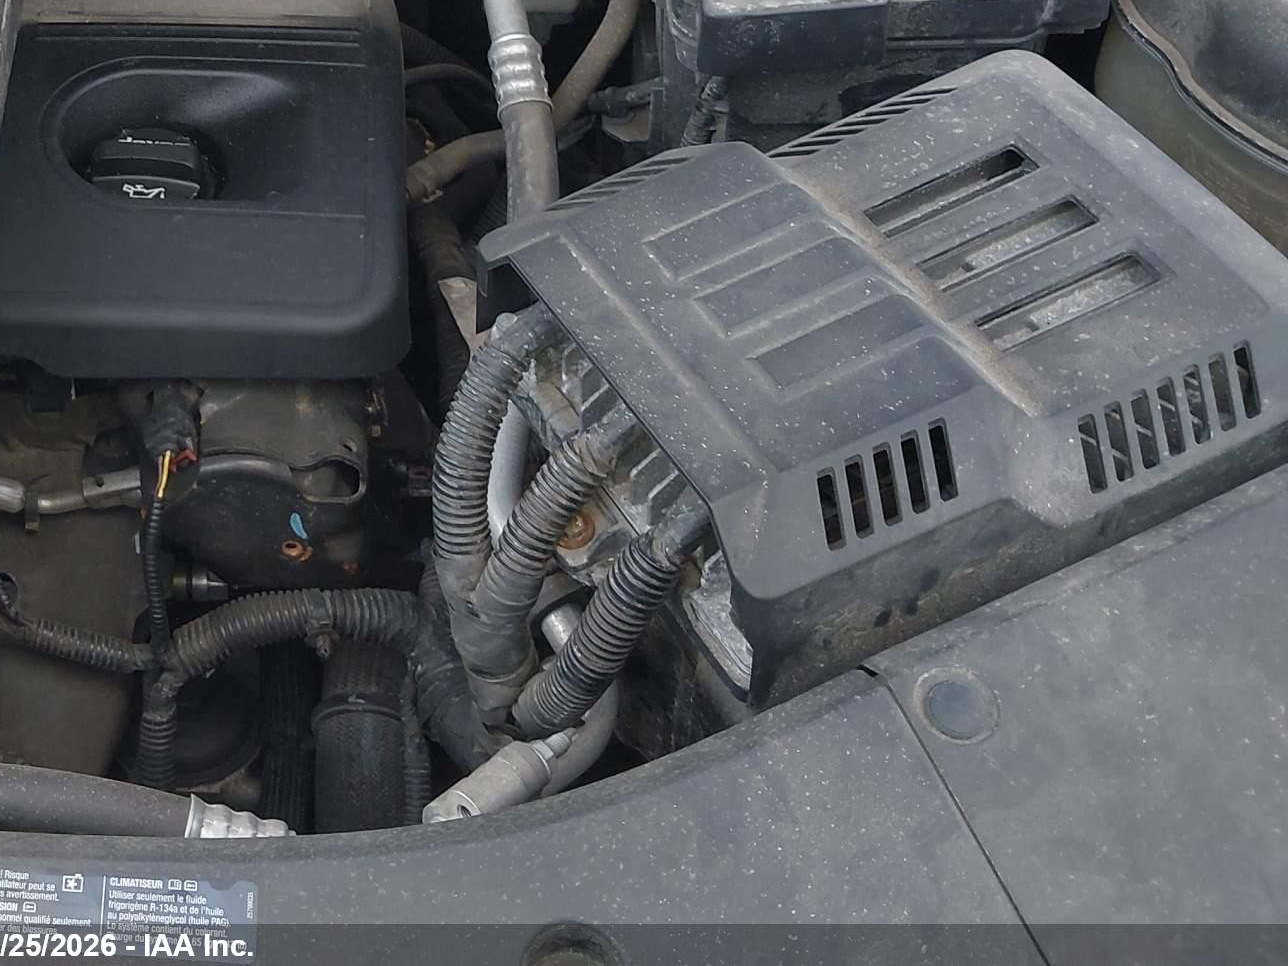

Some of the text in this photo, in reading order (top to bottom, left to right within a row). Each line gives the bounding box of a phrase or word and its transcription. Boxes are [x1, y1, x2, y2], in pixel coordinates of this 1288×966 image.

[4, 870, 30, 880] Risque
[28, 882, 44, 891] peut
[110, 877, 163, 889] CLIMATISEUR
[6, 890, 59, 901] avertissement.
[109, 889, 207, 904] Utiliser seulement le fluide
[150, 903, 178, 912] R-134a
[180, 905, 187, 913] et
[189, 906, 199, 914] de
[188, 916, 209, 925] (huile
[7, 925, 20, 933] des
[107, 921, 116, 930] Le
[152, 925, 181, 934] contient
[183, 926, 192, 935] du
